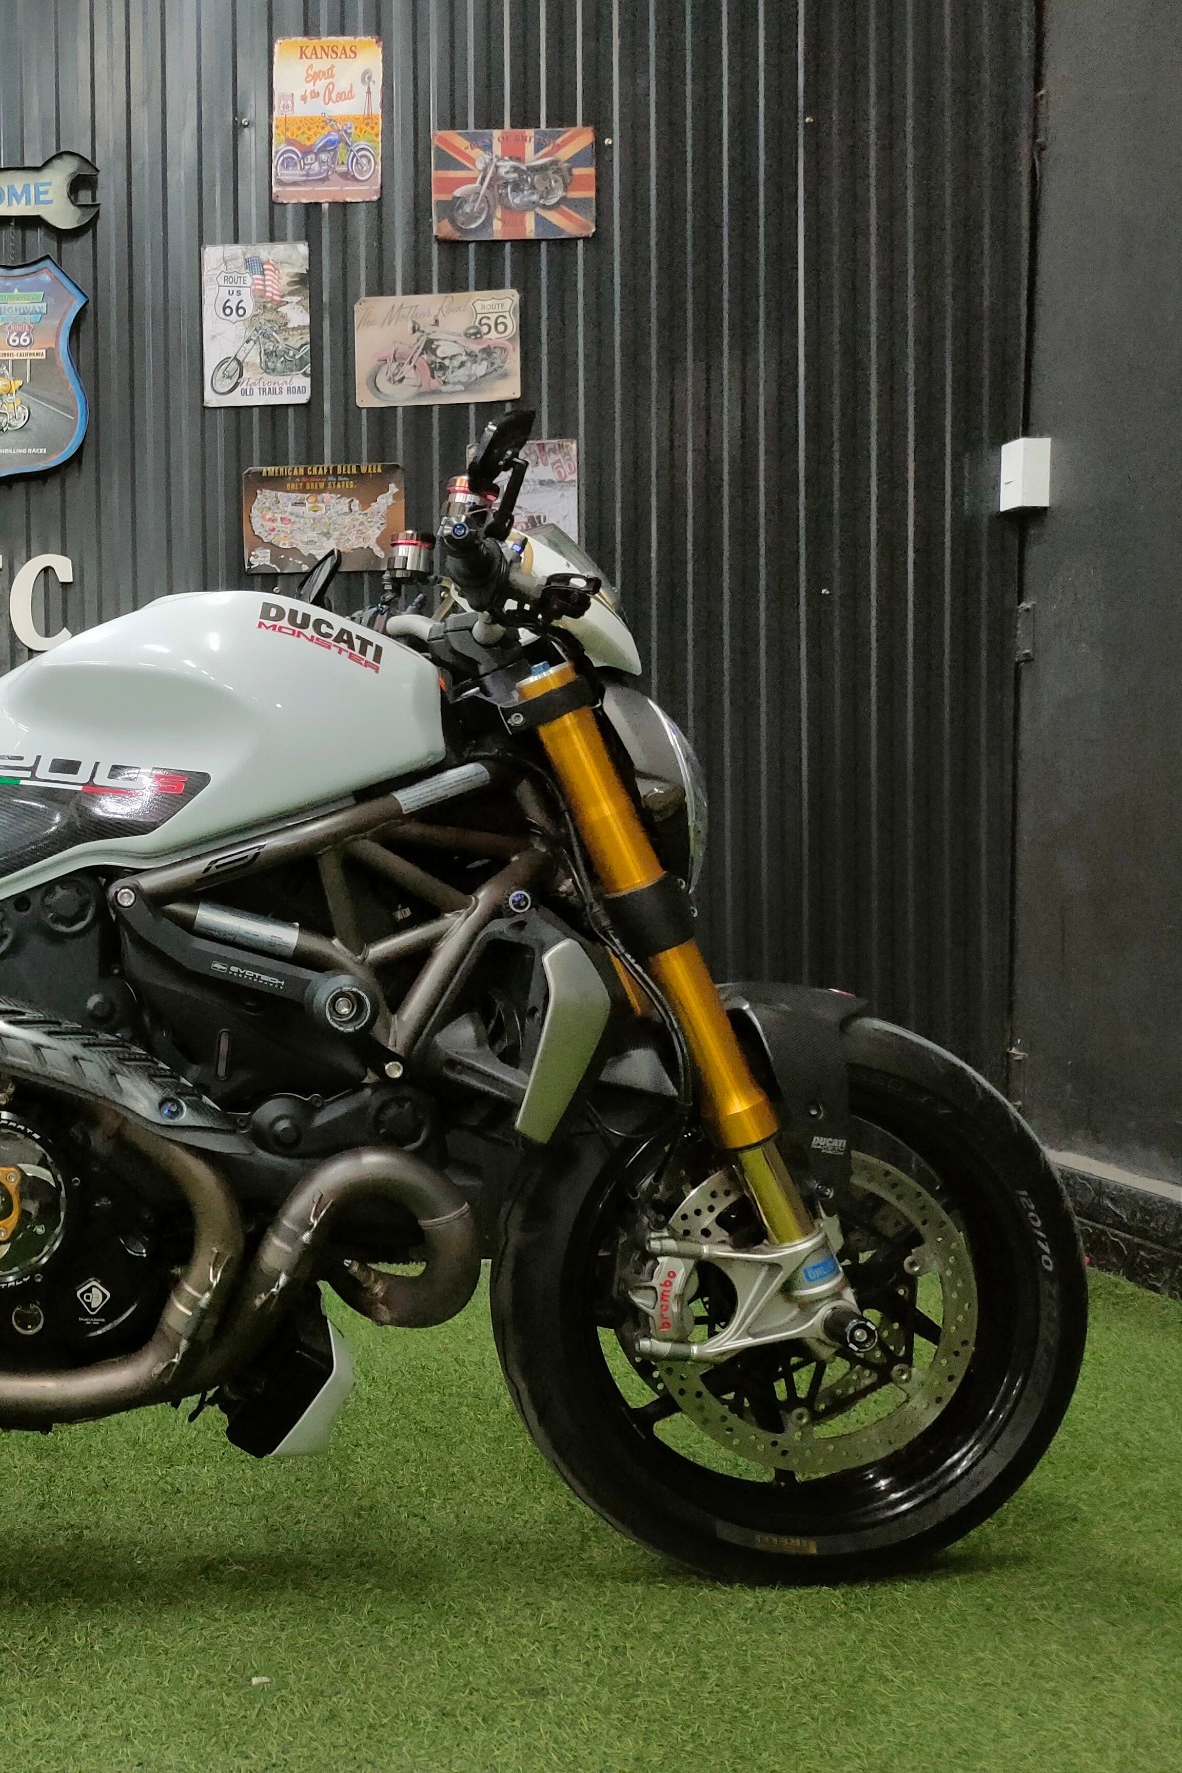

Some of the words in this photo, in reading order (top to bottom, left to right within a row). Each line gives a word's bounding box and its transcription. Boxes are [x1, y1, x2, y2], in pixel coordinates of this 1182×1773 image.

[299, 44, 357, 60] KANSAS
[323, 81, 355, 105] Road
[223, 275, 247, 285] ROUTE
[228, 289, 241, 297] US
[222, 298, 247, 318] 66
[481, 303, 505, 311] ROUTE
[478, 314, 508, 336] 66
[8, 331, 31, 347] 66
[239, 376, 294, 387] National
[241, 387, 254, 397] OLD
[257, 386, 283, 397] TRAILS
[286, 385, 306, 395] ROAD
[261, 467, 304, 477] AMERICAN
[307, 465, 333, 476] CRAFT
[337, 464, 357, 474] BEER
[360, 463, 382, 474] WEEK
[259, 601, 383, 665] DUCATI
[257, 620, 380, 674] MONSTER
[658, 1270, 677, 1331] brembo
